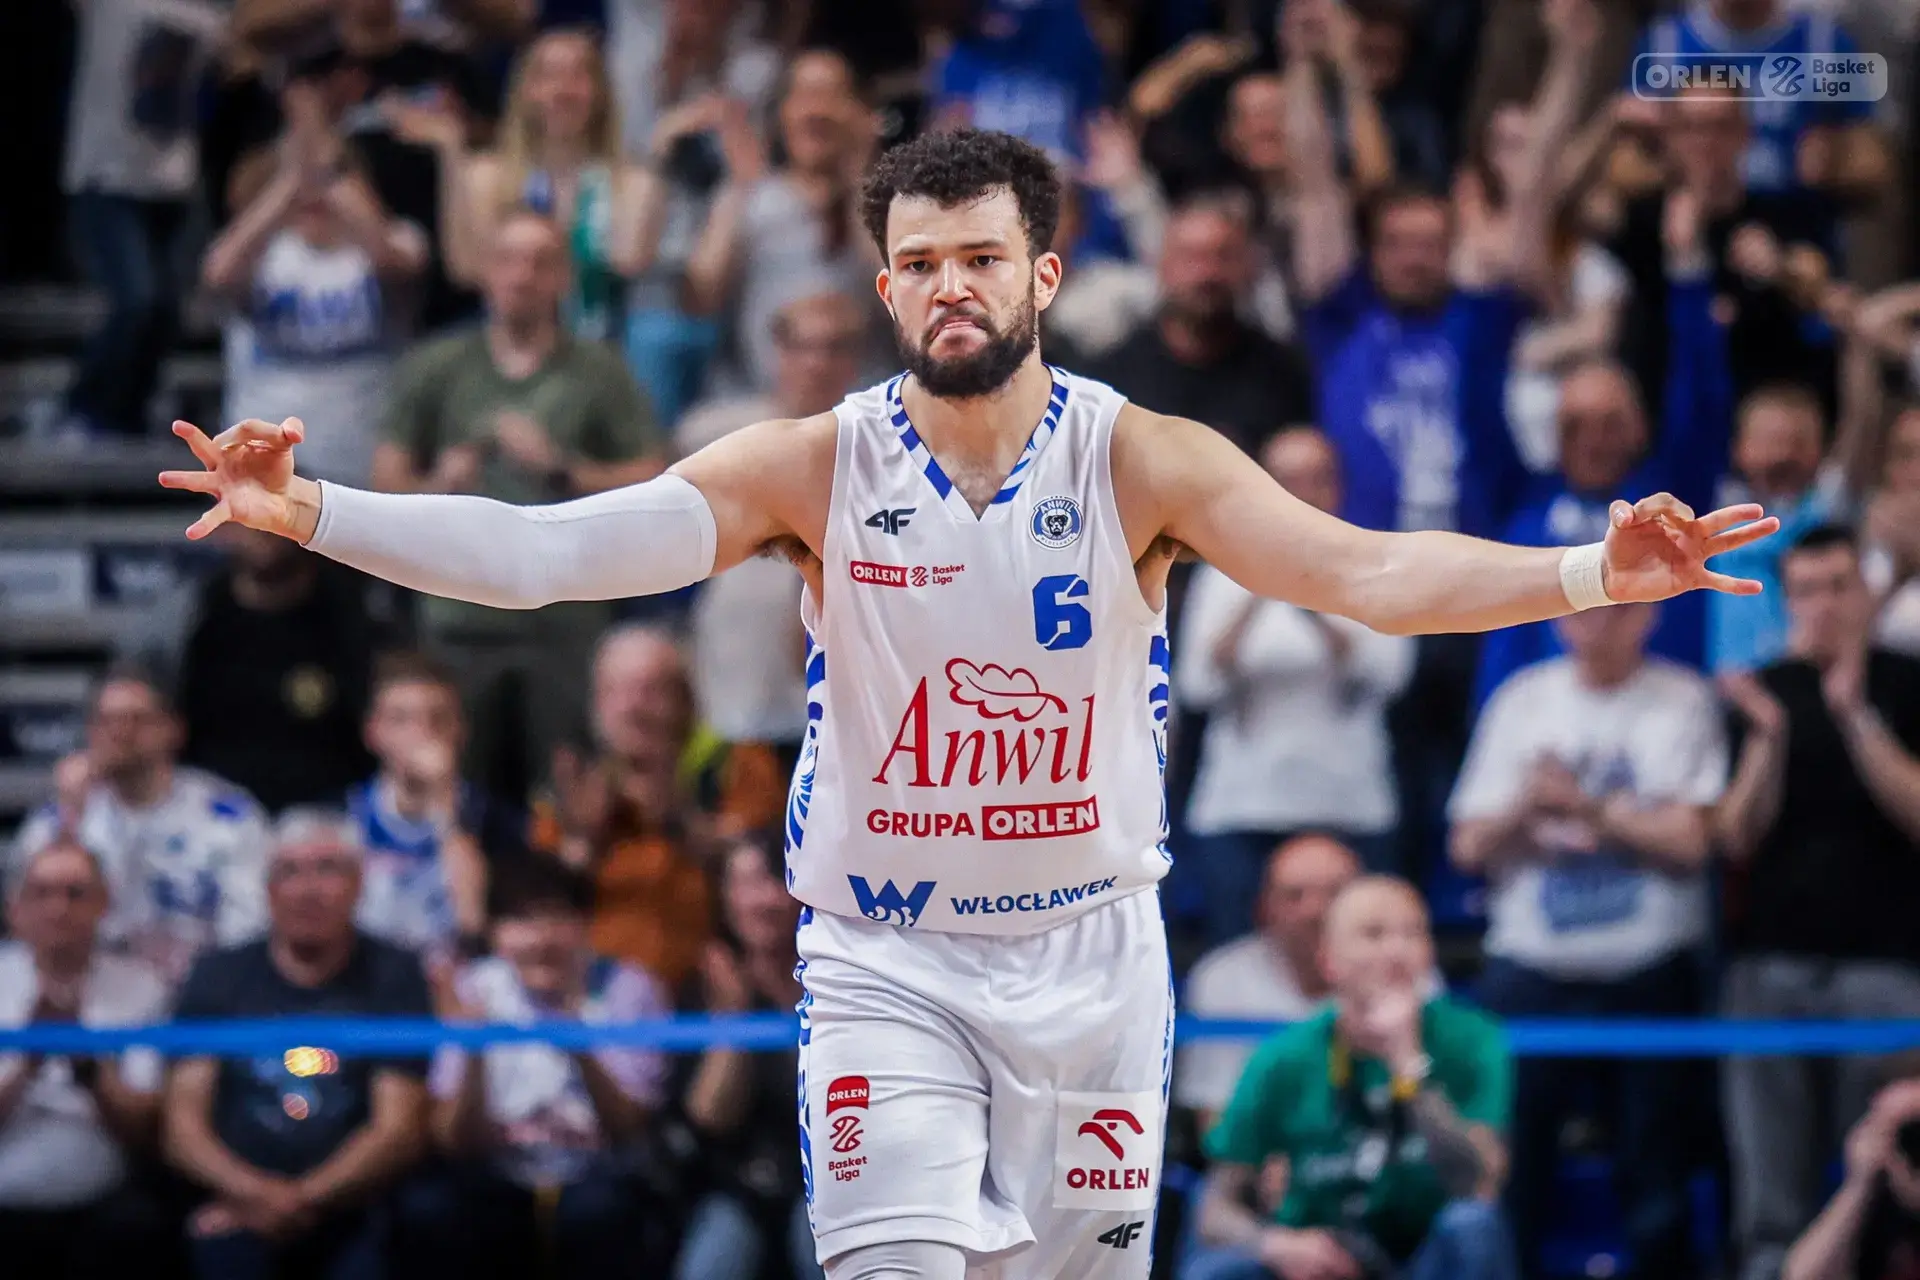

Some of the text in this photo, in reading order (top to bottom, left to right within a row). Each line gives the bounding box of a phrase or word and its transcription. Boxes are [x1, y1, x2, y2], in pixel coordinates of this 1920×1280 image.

[1040, 500, 1074, 514] ANWIL
[864, 507, 917, 536] 4F
[853, 565, 902, 583] ORLEN
[932, 564, 966, 575] Basket
[932, 575, 954, 586] Liga
[1032, 573, 1092, 651] 6
[872, 675, 1096, 788] Anwil
[866, 802, 1097, 838] GRUPA ORLEN
[950, 875, 1119, 915] WŁOCŁAWEK
[828, 1088, 868, 1102] ORLEN
[828, 1156, 868, 1171] Basket
[835, 1169, 860, 1182] Liga
[1066, 1167, 1150, 1190] ORLEN
[1097, 1220, 1145, 1249] 4F
